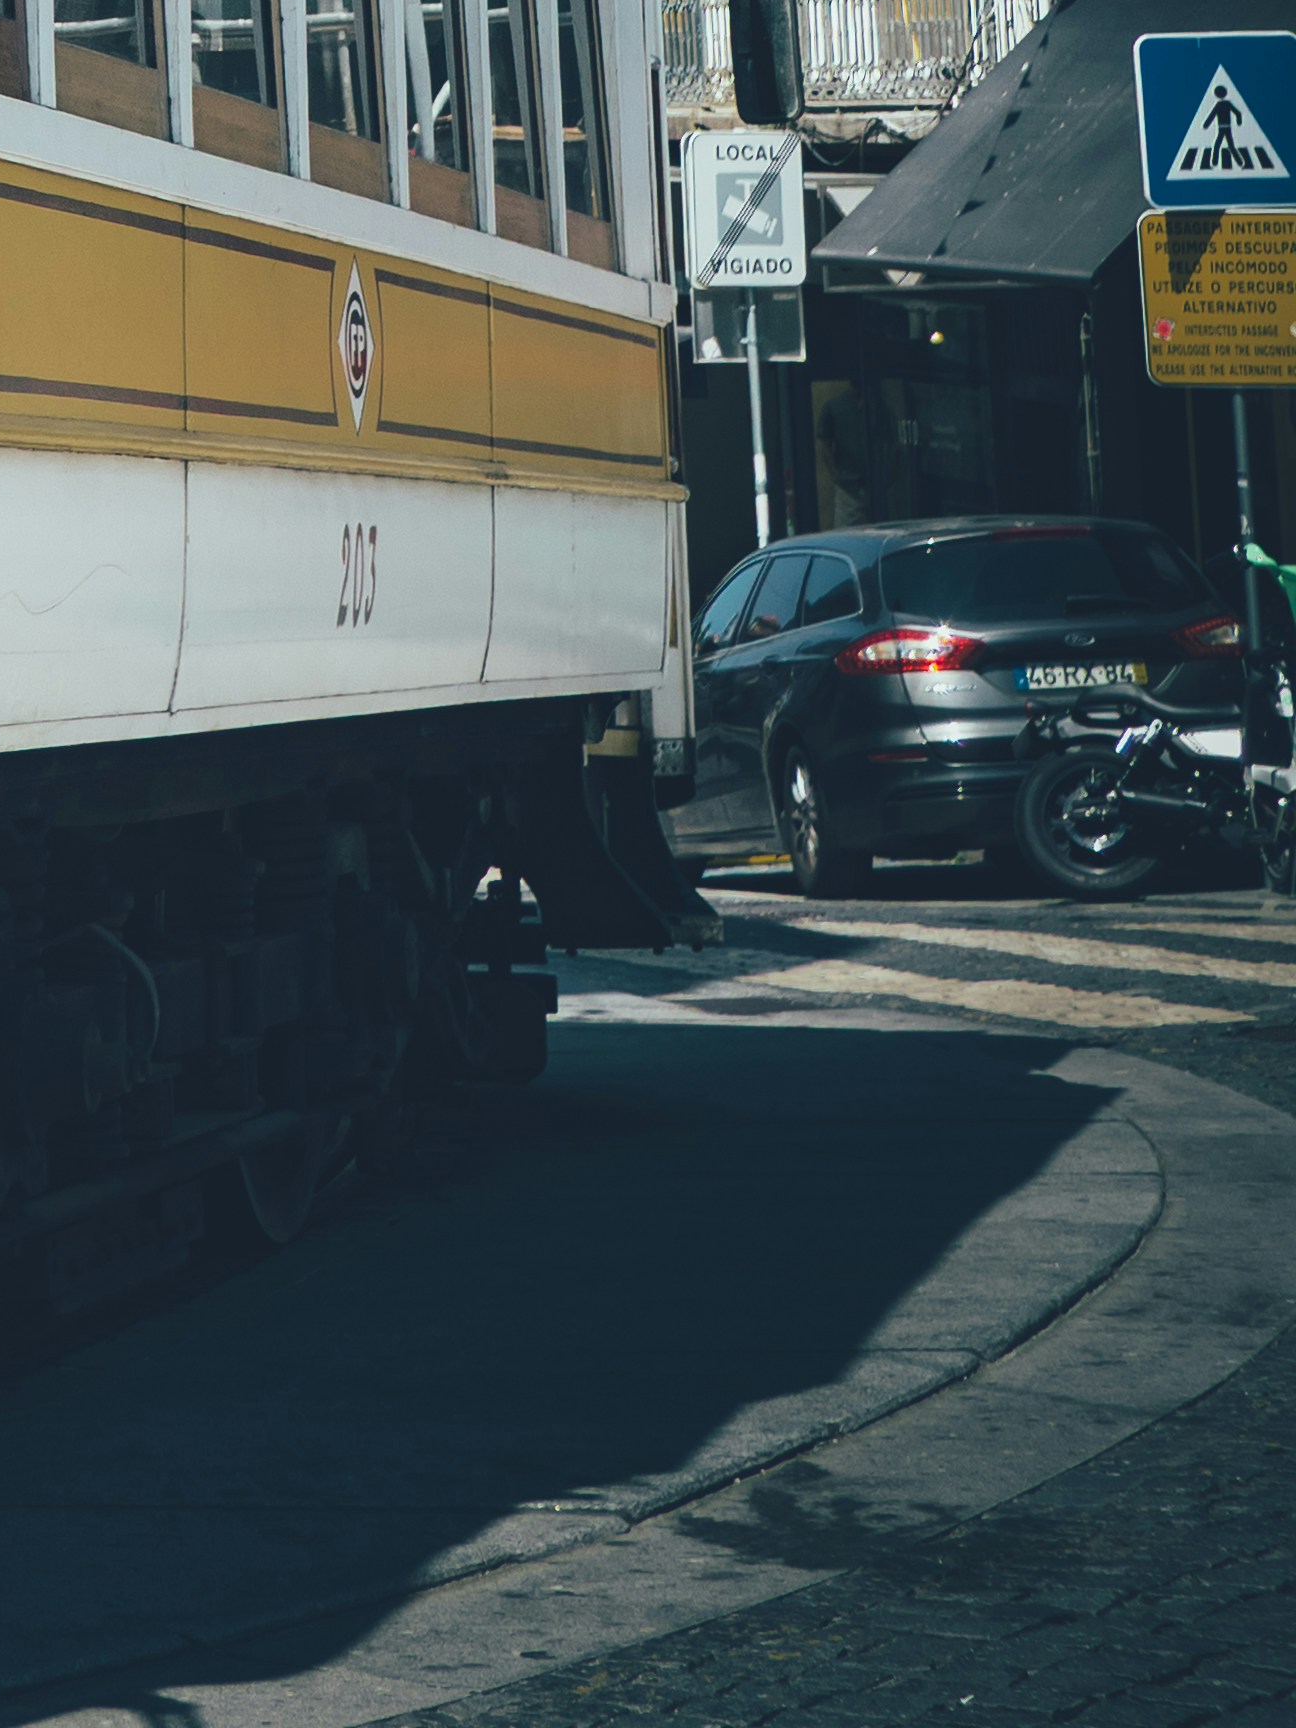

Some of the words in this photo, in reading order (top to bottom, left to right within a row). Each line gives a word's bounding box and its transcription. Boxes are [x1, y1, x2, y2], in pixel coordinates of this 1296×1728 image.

[716, 145, 782, 162] LOCAL
[1147, 221, 1223, 235] PASSAGEM
[1230, 221, 1296, 235] INTERDIT
[1155, 241, 1217, 254] PEDIMOS
[710, 257, 793, 275] VIGIADO
[1169, 261, 1202, 274] PELO
[1210, 258, 1288, 275] INCÓMODO
[1153, 280, 1203, 294] UTILIZE
[1211, 280, 1221, 294] O
[1229, 280, 1296, 294] PERCURS
[1183, 300, 1277, 314] ALTERNATIVO
[1184, 324, 1237, 337] INTERDICTED
[1241, 324, 1278, 337] PASSAGE
[1167, 344, 1210, 356] APOLOGIZE
[1215, 344, 1230, 356] FOR
[1235, 344, 1249, 356] THE
[1156, 364, 1185, 376] PLEASE
[1191, 364, 1205, 376] USE
[1210, 364, 1224, 376] THE
[1229, 364, 1282, 377] ALTERNATIVE
